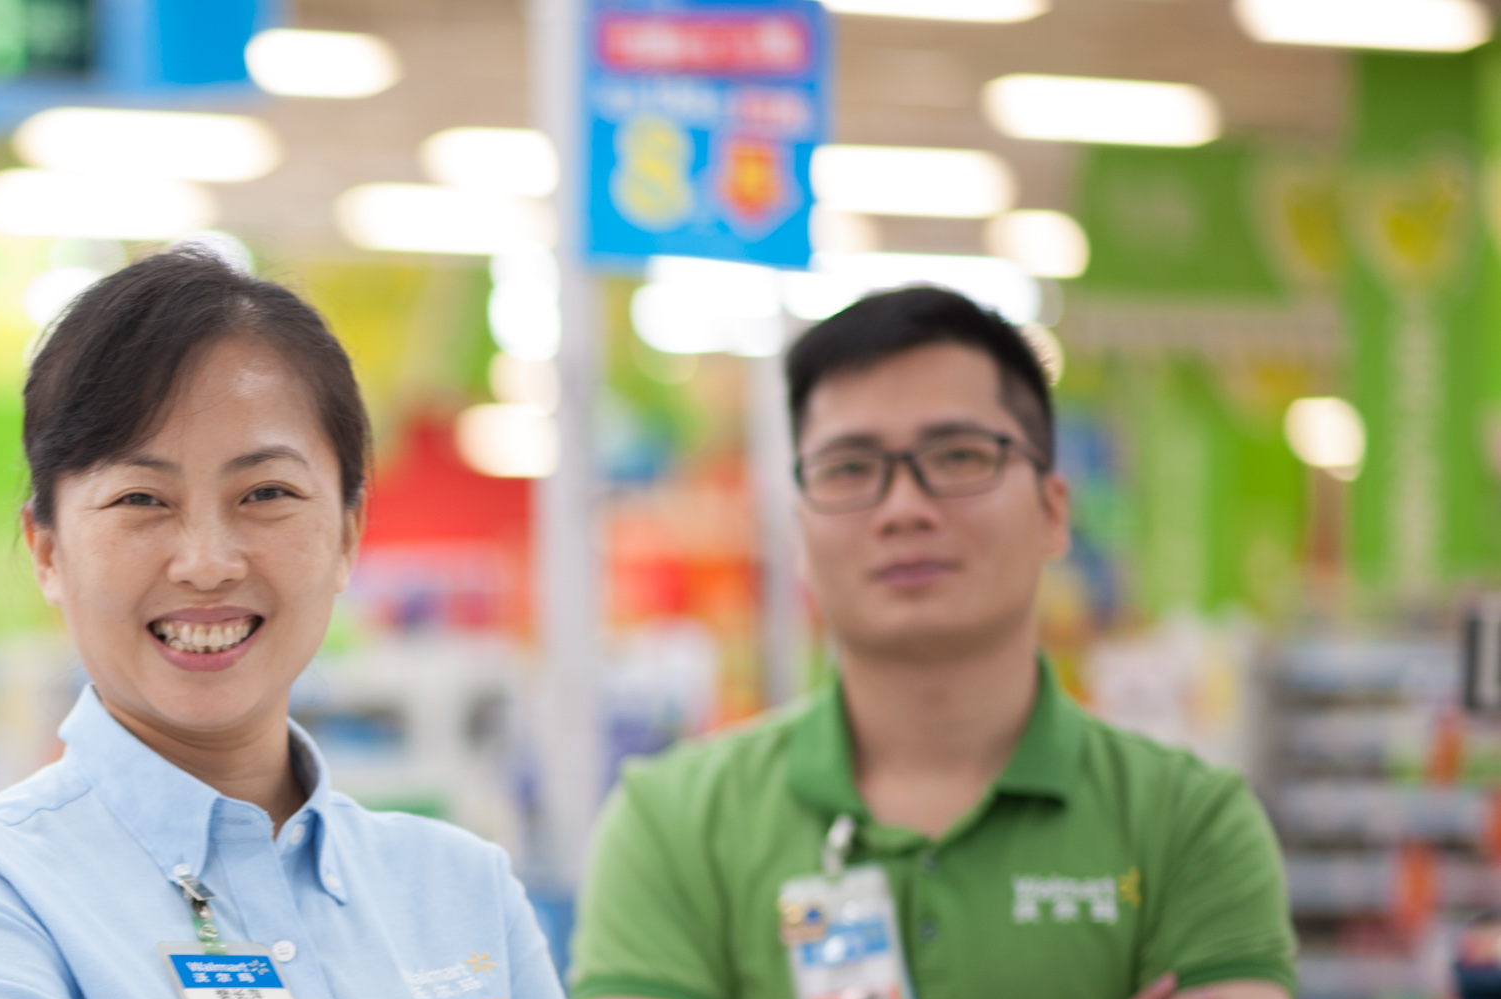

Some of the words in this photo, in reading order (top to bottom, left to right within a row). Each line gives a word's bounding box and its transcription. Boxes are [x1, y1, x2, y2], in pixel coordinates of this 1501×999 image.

[185, 961, 250, 973] Walmart
[192, 972, 256, 983] 沃尔玛
